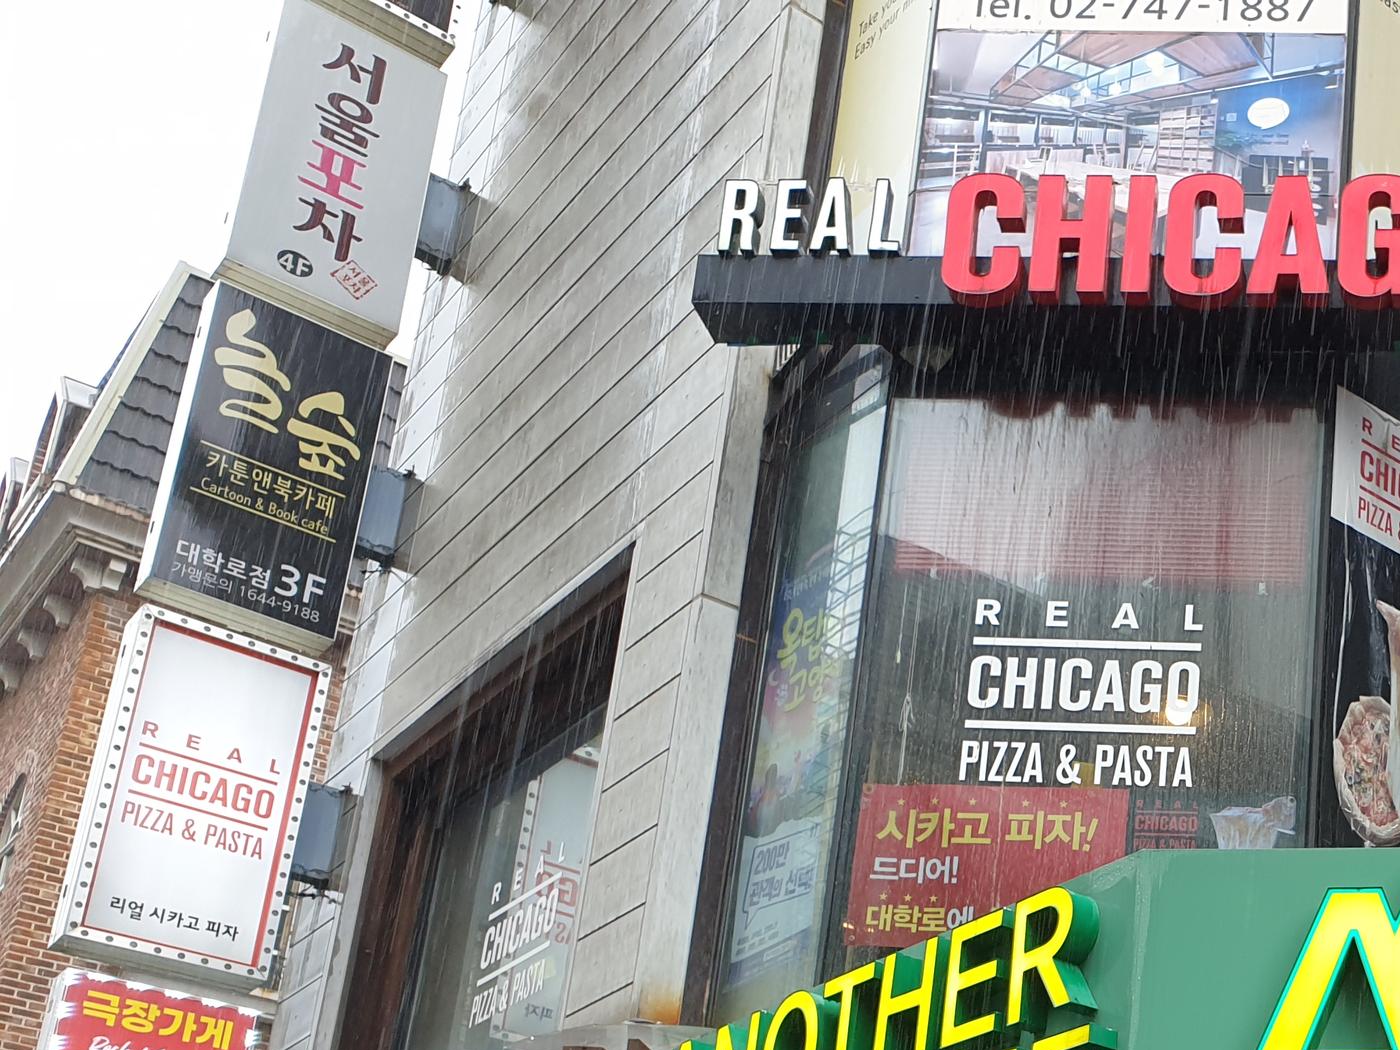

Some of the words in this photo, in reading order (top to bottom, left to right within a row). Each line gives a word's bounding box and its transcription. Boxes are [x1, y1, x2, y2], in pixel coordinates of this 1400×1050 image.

[854, 32, 877, 60] Easy
[291, 42, 388, 264] 서울포차
[718, 177, 902, 254] REAL
[279, 252, 311, 278] 4F
[200, 476, 252, 507] Cartoon
[255, 497, 265, 512] &
[268, 501, 299, 525] Book
[301, 516, 329, 536] cafe
[205, 450, 337, 520] 카툰앤북카페
[1358, 496, 1394, 537] PIZZA
[175, 538, 272, 590] 대학로점
[273, 564, 328, 606] 3F
[170, 560, 234, 595] 가맹문의
[239, 586, 322, 625] 1644-9188
[975, 598, 1204, 632] REAL
[966, 655, 1201, 714] CHICAGO
[141, 720, 282, 775] REAL
[958, 739, 1044, 784] PIZZA
[1055, 744, 1083, 785] &
[1092, 744, 1194, 788] PASTA
[131, 754, 276, 820] CHICAGO
[120, 800, 175, 836] PIZZA
[181, 818, 197, 843] &
[203, 823, 265, 861] PASTA
[875, 807, 992, 849] 시카고
[1004, 810, 1099, 852] 피자!
[1134, 815, 1199, 832] CHICAGO
[490, 841, 566, 905] REAL
[869, 854, 959, 885] 드디어!
[109, 896, 145, 921] 리얼
[148, 906, 201, 932] 시카고
[205, 919, 240, 942] 피자
[480, 887, 560, 971] CHICAGO
[468, 984, 499, 1029] PIZZA
[498, 980, 509, 1013] &
[510, 958, 547, 1007] PASTA
